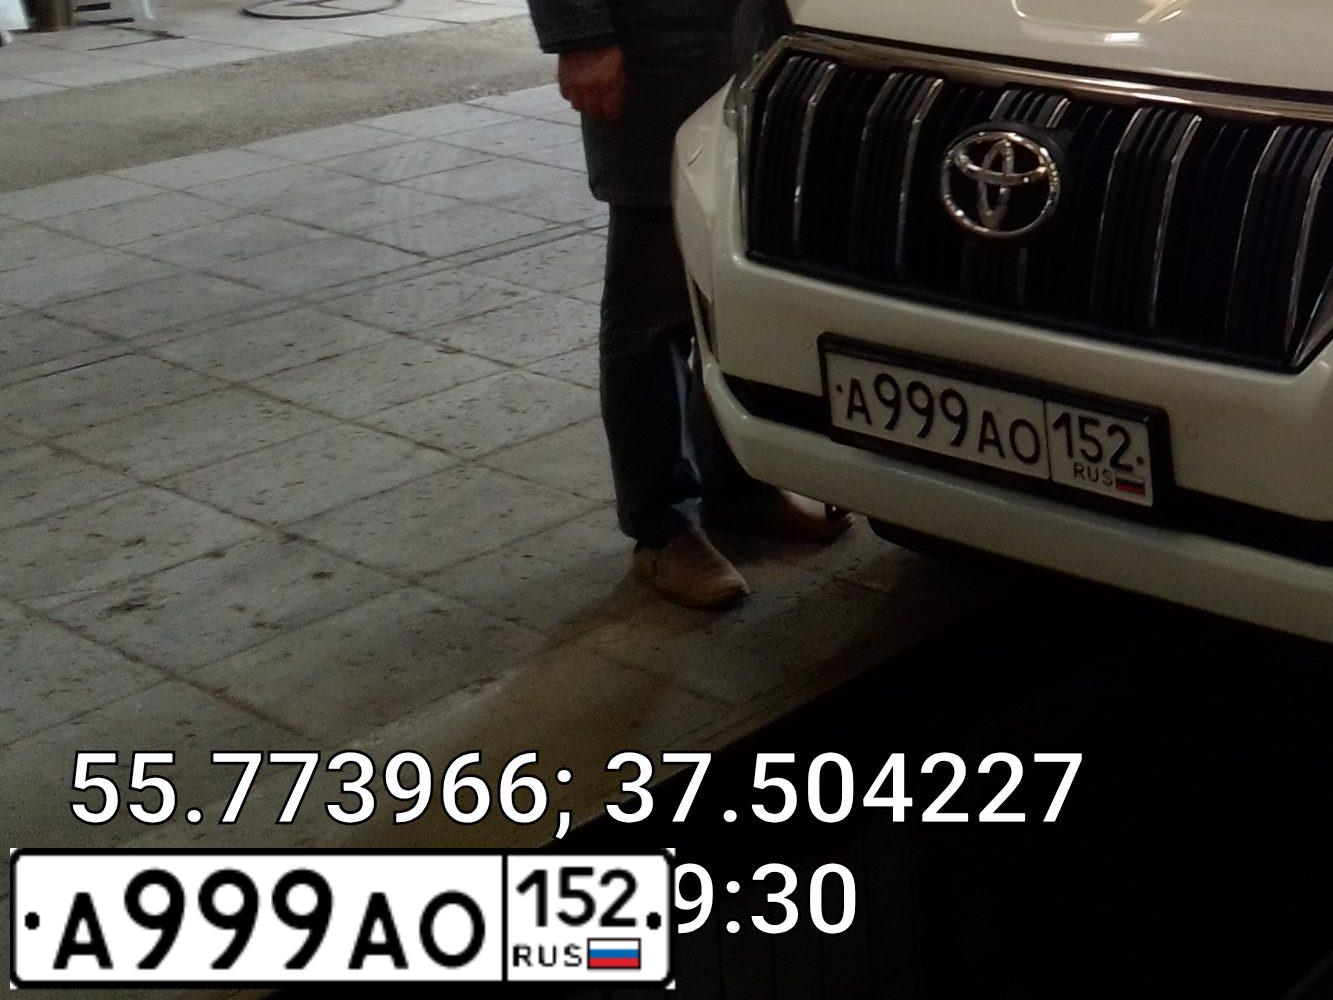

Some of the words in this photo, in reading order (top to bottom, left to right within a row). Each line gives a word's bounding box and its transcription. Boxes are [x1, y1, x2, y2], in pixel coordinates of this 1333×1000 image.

[847, 373, 1041, 465] A999AO
[1052, 411, 1133, 473] 152
[1073, 461, 1113, 487] RUS
